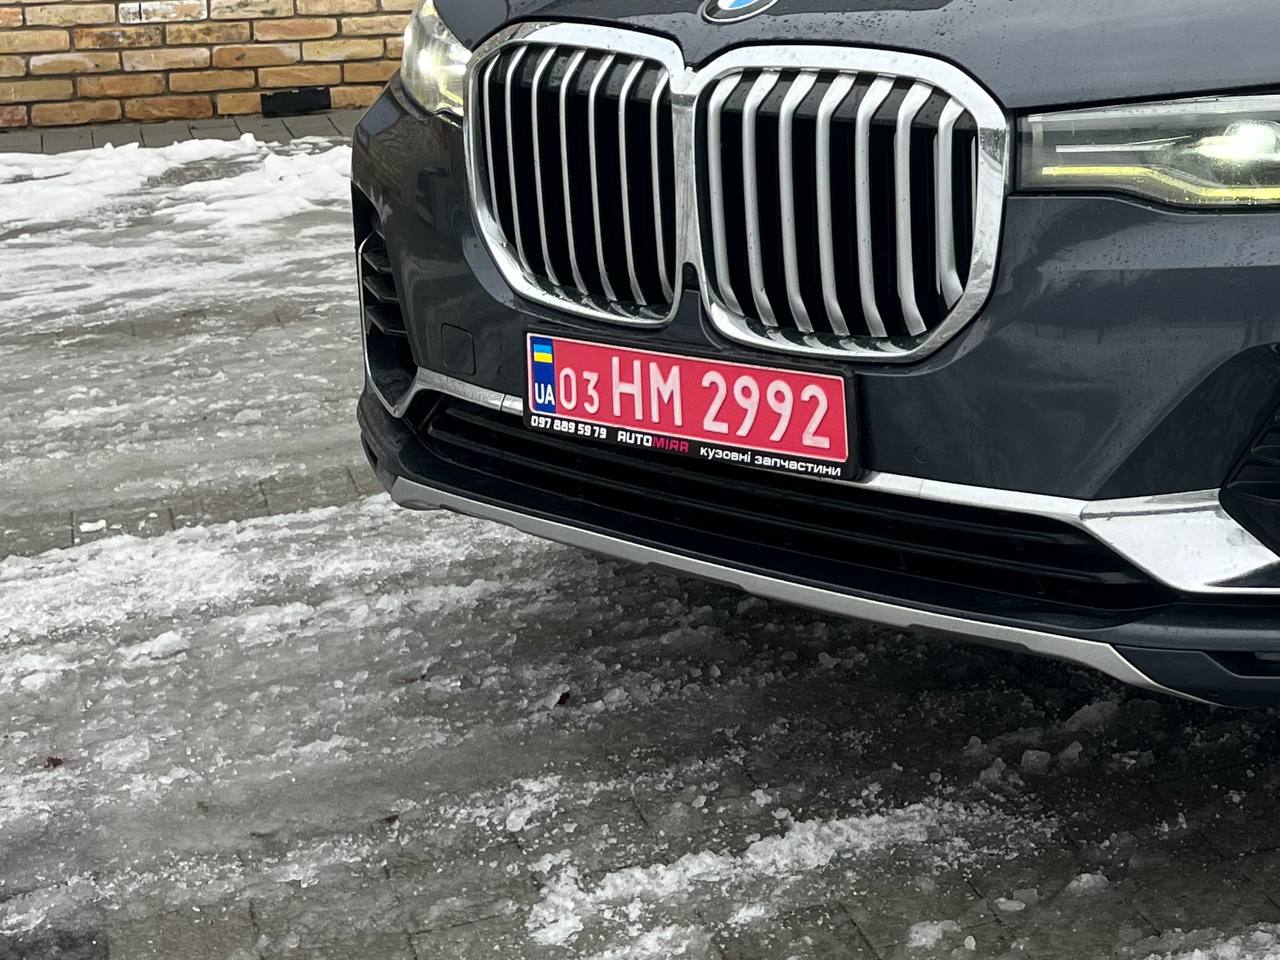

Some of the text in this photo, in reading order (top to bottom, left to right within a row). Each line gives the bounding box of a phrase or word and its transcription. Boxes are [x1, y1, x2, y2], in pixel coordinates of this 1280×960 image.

[534, 382, 556, 406] UA
[558, 356, 831, 449] 03 HM 2992
[530, 415, 551, 429] 097
[553, 419, 575, 433] 889
[754, 454, 842, 477] запчастини
